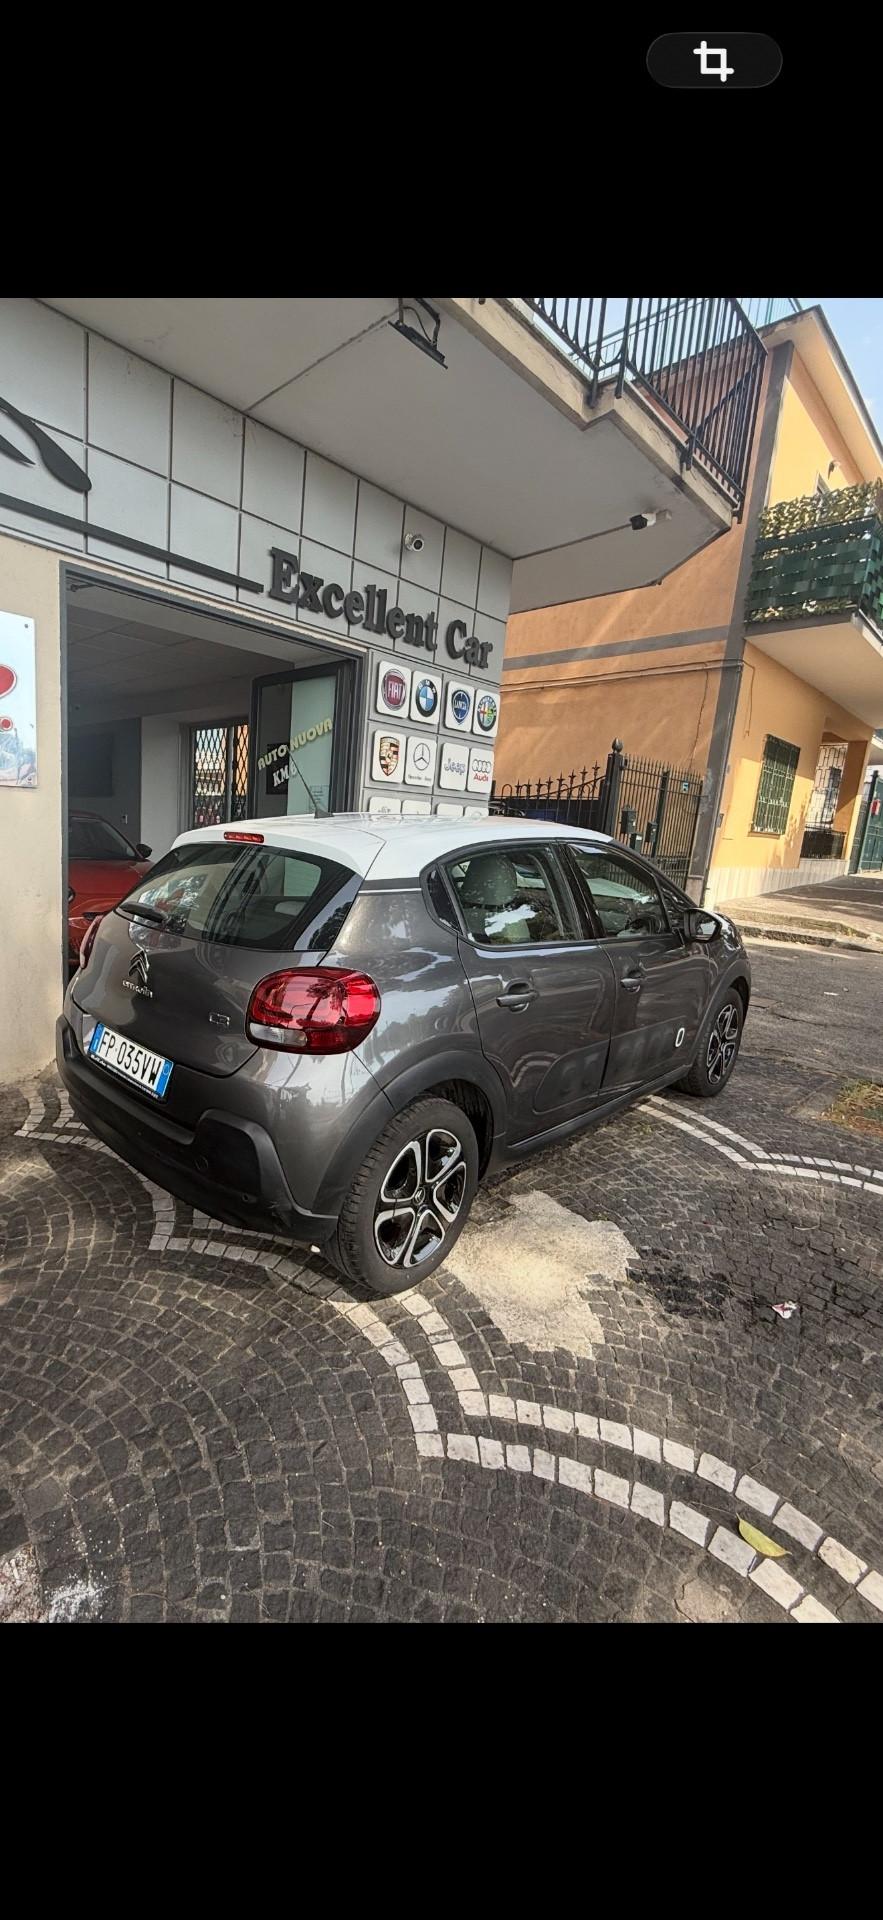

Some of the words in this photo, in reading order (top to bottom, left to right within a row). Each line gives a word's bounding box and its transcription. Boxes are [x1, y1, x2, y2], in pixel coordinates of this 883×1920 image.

[268, 546, 438, 652] Excellent
[446, 619, 493, 669] Car
[387, 680, 404, 700] FIAT
[257, 744, 289, 771] AUTO
[289, 718, 333, 752] NUOVA
[444, 758, 466, 775] Jeep
[474, 773, 489, 782] Audi
[98, 1030, 116, 1058] FP
[116, 1041, 162, 1086] 035VW
